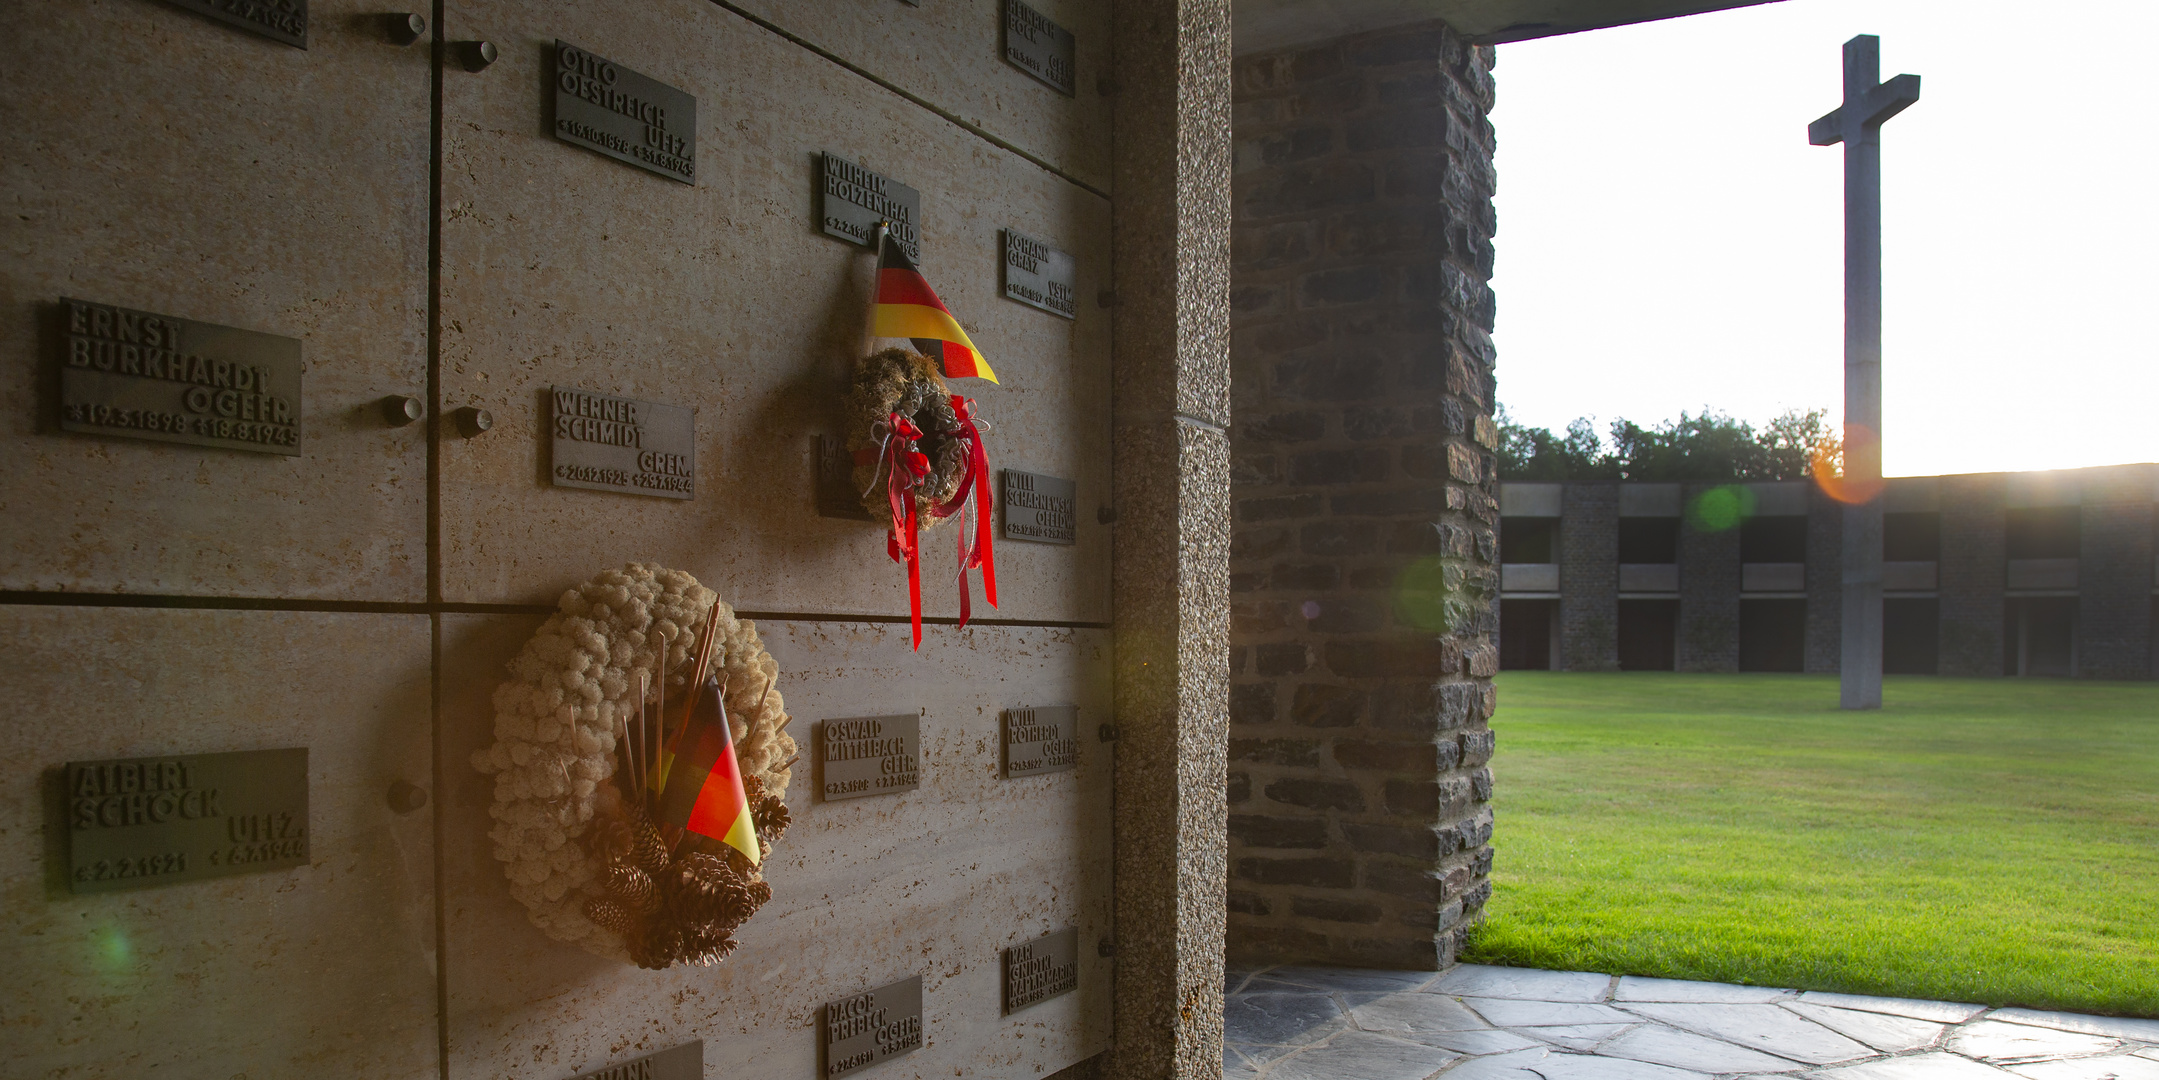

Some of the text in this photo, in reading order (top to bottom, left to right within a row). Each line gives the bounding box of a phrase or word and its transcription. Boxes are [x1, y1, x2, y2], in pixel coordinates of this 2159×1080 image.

[1008, 0, 1054, 40] HEINRICH
[1008, 13, 1036, 44] BOCK
[561, 46, 618, 87] OTTO
[560, 71, 666, 131] OESTREICH
[645, 125, 694, 161] UFFZ.
[826, 156, 887, 197] WILHELM
[826, 175, 911, 225] HOLZENTHAL
[1008, 232, 1049, 263] JOHANN
[1008, 250, 1038, 275] GRATZ
[70, 303, 179, 351] ERNST
[69, 338, 269, 395] BURKHARDT
[183, 386, 298, 426] OGEFR.
[556, 391, 638, 424] WERNER
[556, 415, 643, 448] SCHMIDT
[638, 451, 691, 477] GREN.
[1007, 472, 1035, 491] WILLI
[1007, 489, 1074, 514] SCHARNEWSKI
[825, 720, 881, 741] OSWALD
[1010, 710, 1035, 726] WILLI
[825, 737, 904, 761] MITTELBACH
[881, 755, 917, 774] GEFR.
[73, 761, 195, 798] ALBERT
[227, 811, 303, 843] UFFZ.
[1011, 944, 1033, 965] KARL
[830, 993, 874, 1023] JACOB
[830, 1007, 888, 1044] PREBECK
[875, 1015, 920, 1045] OGEFR.
